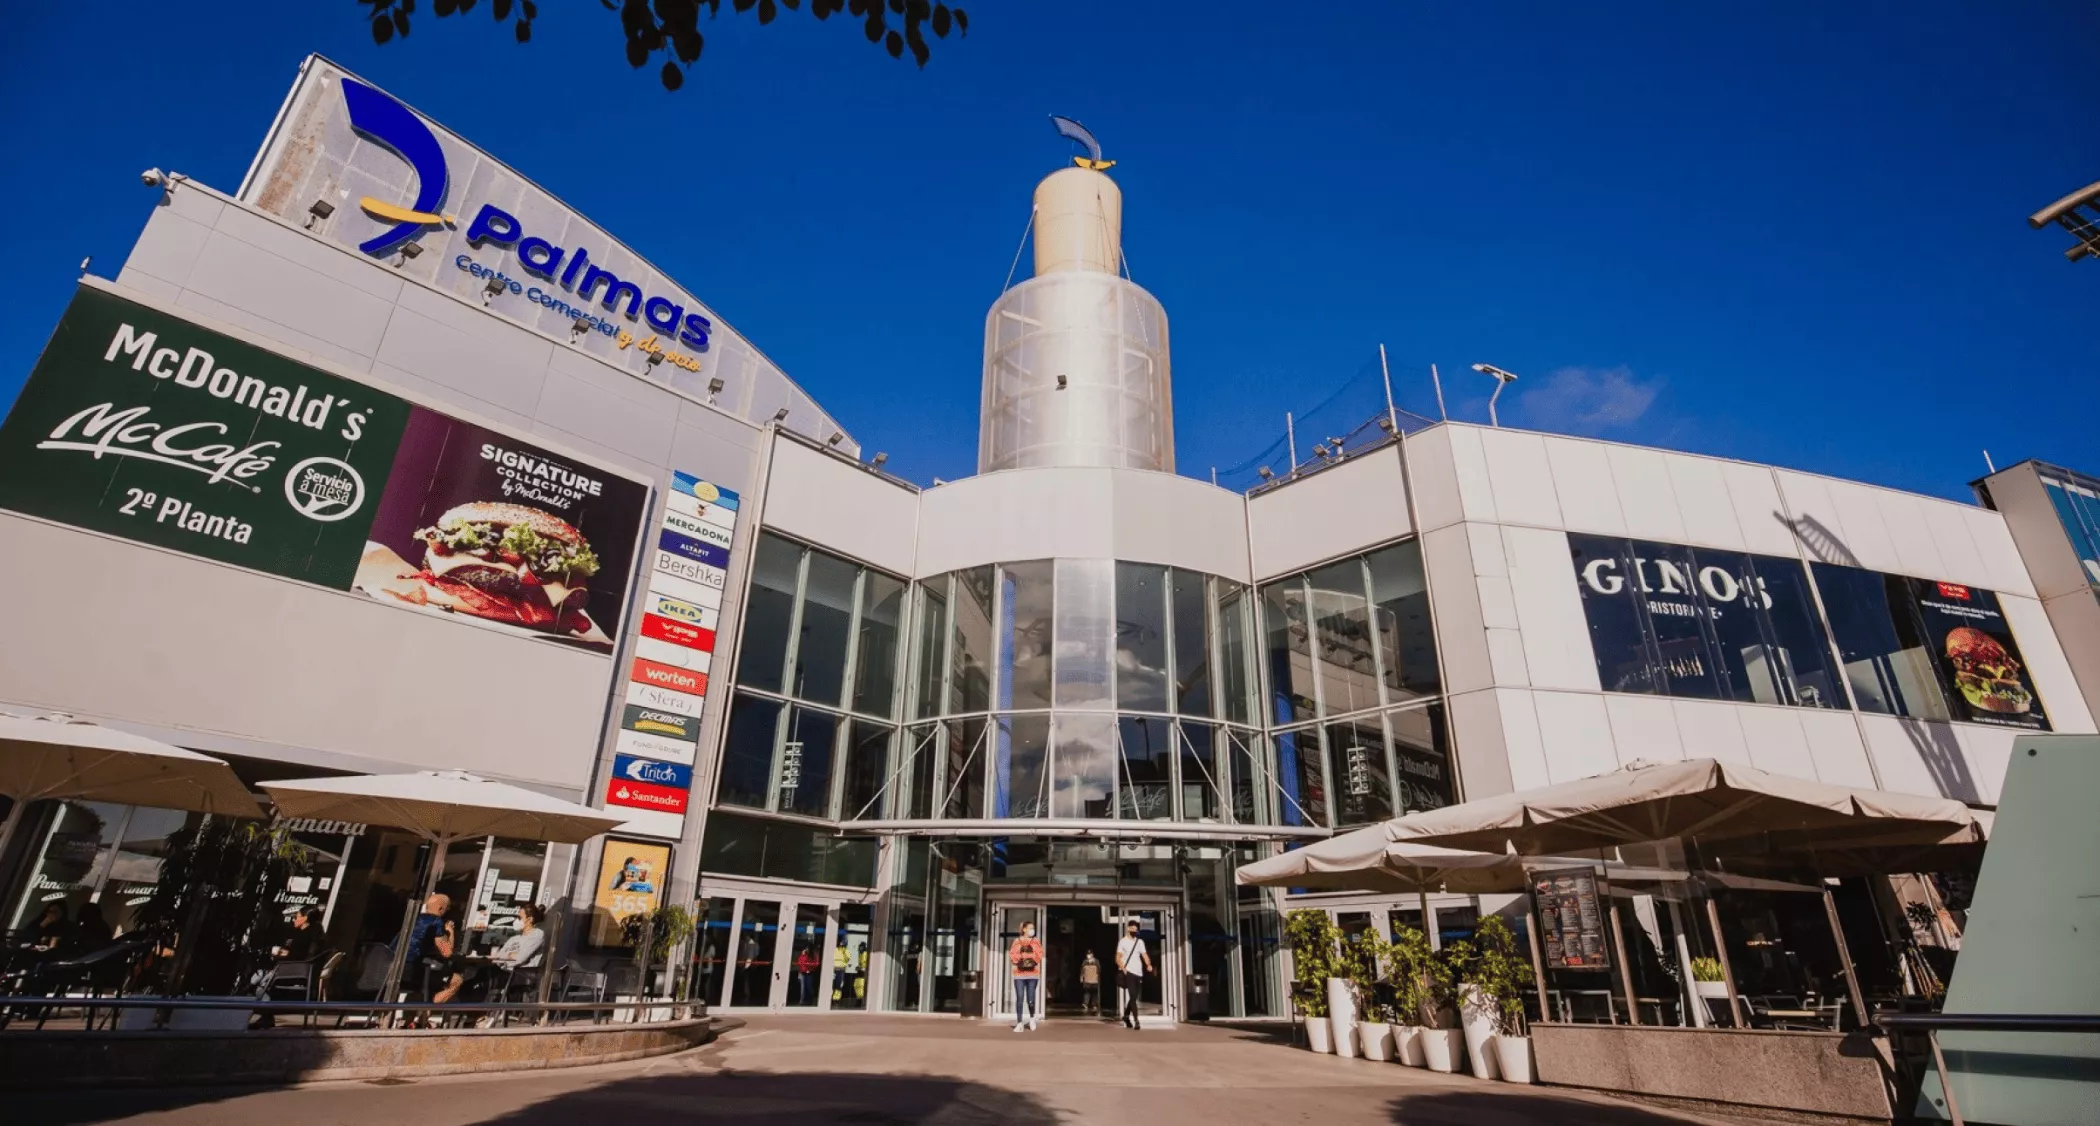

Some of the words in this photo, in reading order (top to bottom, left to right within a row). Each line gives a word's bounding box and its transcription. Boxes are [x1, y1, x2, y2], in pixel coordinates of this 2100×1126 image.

[466, 203, 712, 351] Palmas
[527, 287, 620, 339] Comercial
[617, 331, 633, 350] y
[637, 334, 661, 353] de
[665, 351, 701, 373] ocio
[48, 402, 282, 485] McCafé
[304, 468, 353, 492] Servicio
[480, 444, 602, 496] SIGNATURE
[301, 480, 310, 491] a
[313, 483, 350, 503] mesa
[496, 466, 582, 501] COLLECTION
[501, 478, 514, 496] by
[156, 497, 253, 545] Planta
[666, 515, 730, 545] MERCADONA
[680, 543, 710, 558] ALTAFIT
[659, 553, 722, 586] Bershka
[664, 603, 696, 618] IKEA
[645, 667, 696, 689] worten
[638, 710, 688, 726] DECIMAS
[643, 764, 677, 783] Triton
[632, 789, 681, 807] Santander
[610, 894, 648, 914] 365
